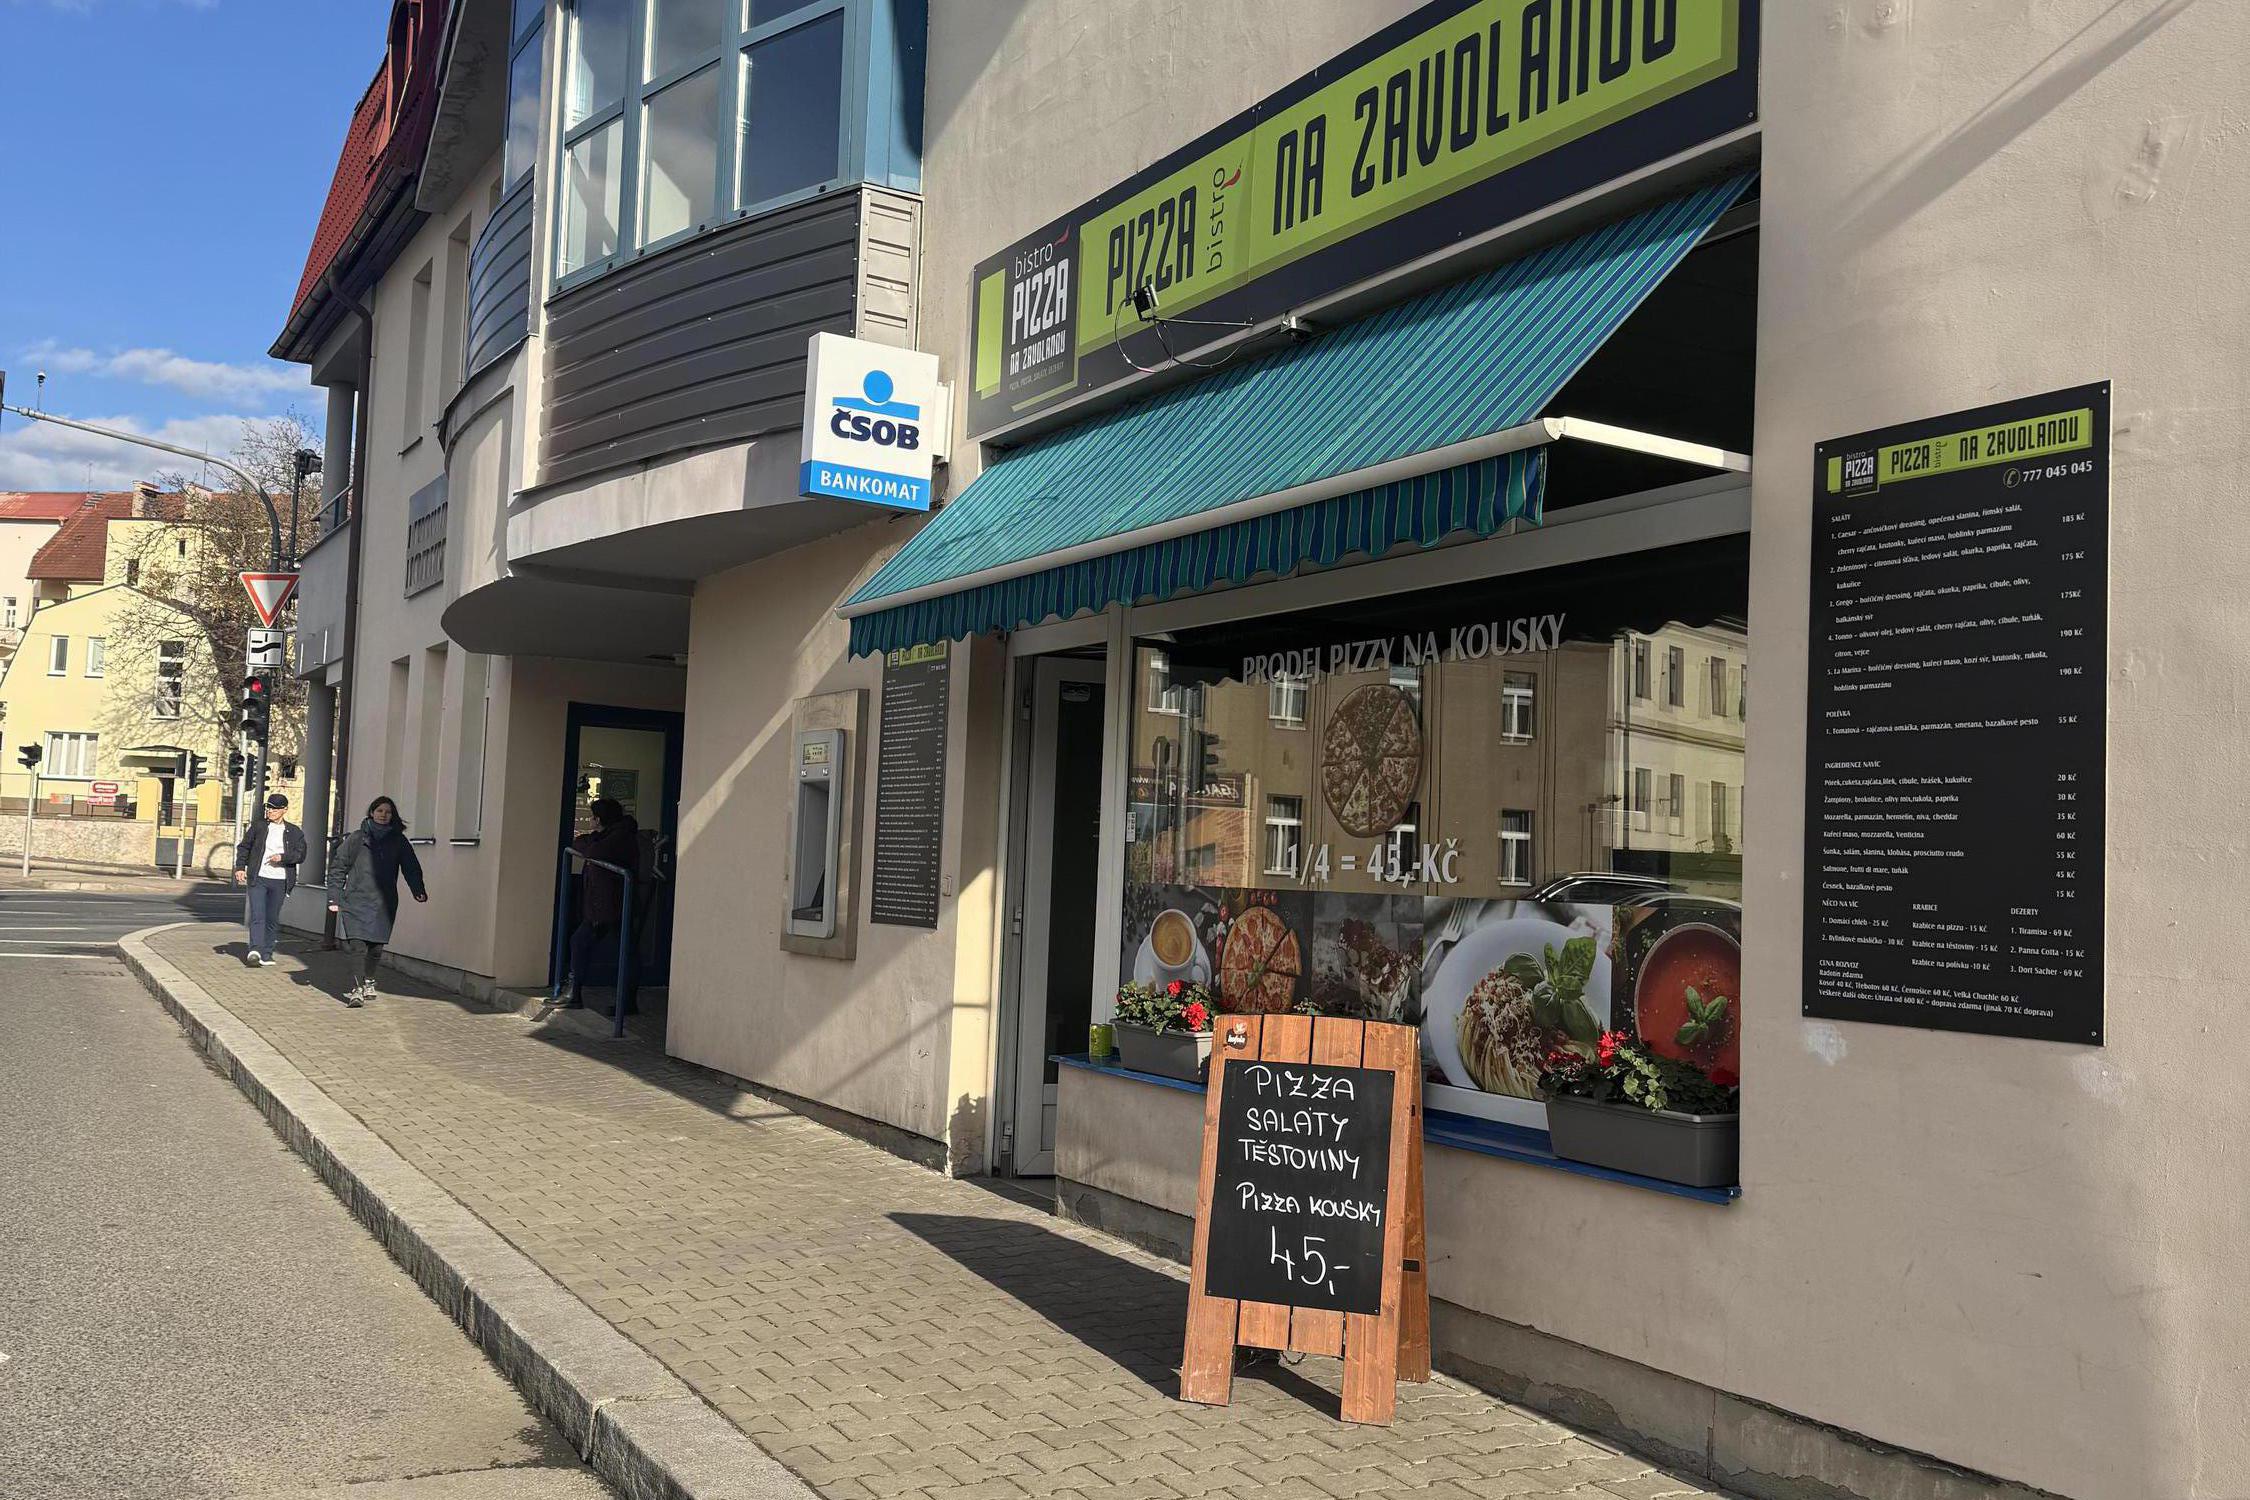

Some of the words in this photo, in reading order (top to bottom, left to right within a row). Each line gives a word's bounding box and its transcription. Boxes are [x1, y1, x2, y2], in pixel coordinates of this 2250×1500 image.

[1272, 114, 1327, 236] NA
[1206, 167, 1225, 274] bistro
[1106, 185, 1196, 316] PIZZA
[1011, 258, 1069, 345] PIZZA
[830, 408, 920, 450] ČSOB
[1891, 445, 1929, 475] PIZZA
[1959, 437, 1979, 462] NA
[1845, 456, 1873, 478] PIZZA
[2022, 468, 2042, 482] 777
[2045, 464, 2067, 478] 045
[2070, 460, 2092, 474] 045
[820, 470, 920, 501] BANKOMAT
[2062, 514, 2075, 523] 185
[2076, 512, 2084, 521] Kč
[2061, 552, 2074, 561] 175
[2075, 550, 2084, 559] Kč
[2060, 629, 2073, 637] 190
[2074, 627, 2083, 636] Kč
[1243, 647, 1320, 686] PRODEJ
[1329, 637, 1395, 674] PIZZY
[1403, 631, 1440, 666] NA
[1450, 613, 1566, 661] KOUSKY
[2059, 667, 2072, 675] 190
[2073, 666, 2082, 674] Kč
[2068, 715, 2077, 723] Kč
[2067, 773, 2076, 781] Kč
[2057, 793, 2066, 801] 30
[2067, 792, 2076, 800] Kč
[2057, 812, 2065, 820] 35
[2067, 812, 2076, 820] Kč
[2067, 831, 2075, 839] Kč
[2056, 851, 2065, 859] 55
[2066, 851, 2075, 859] Kč
[2055, 870, 2064, 878] 45
[2066, 870, 2075, 878] Kč
[2056, 890, 2064, 898] 15
[2066, 890, 2075, 898] Kč
[2010, 907, 2038, 915] DEZERTY
[1244, 1065, 1354, 1101] PIZZA
[1238, 1138, 1360, 1180] TĚSTOVINY
[1309, 1196, 1381, 1227] KOUSKY
